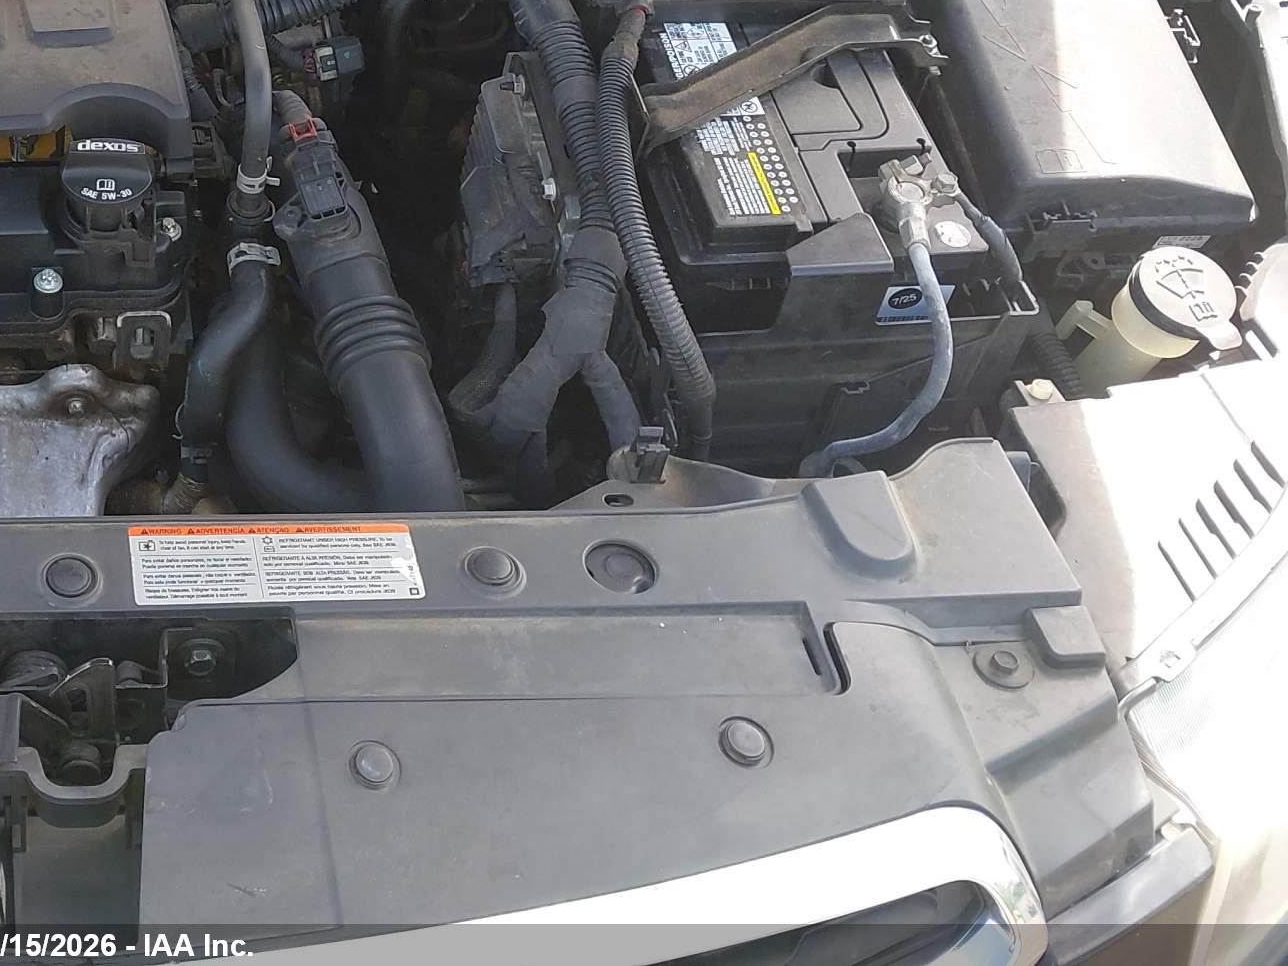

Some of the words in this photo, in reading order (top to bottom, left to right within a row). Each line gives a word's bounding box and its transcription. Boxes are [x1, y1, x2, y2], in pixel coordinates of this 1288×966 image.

[77, 139, 139, 152] dexos
[81, 187, 98, 199] SAE
[101, 188, 132, 200] 5W-30
